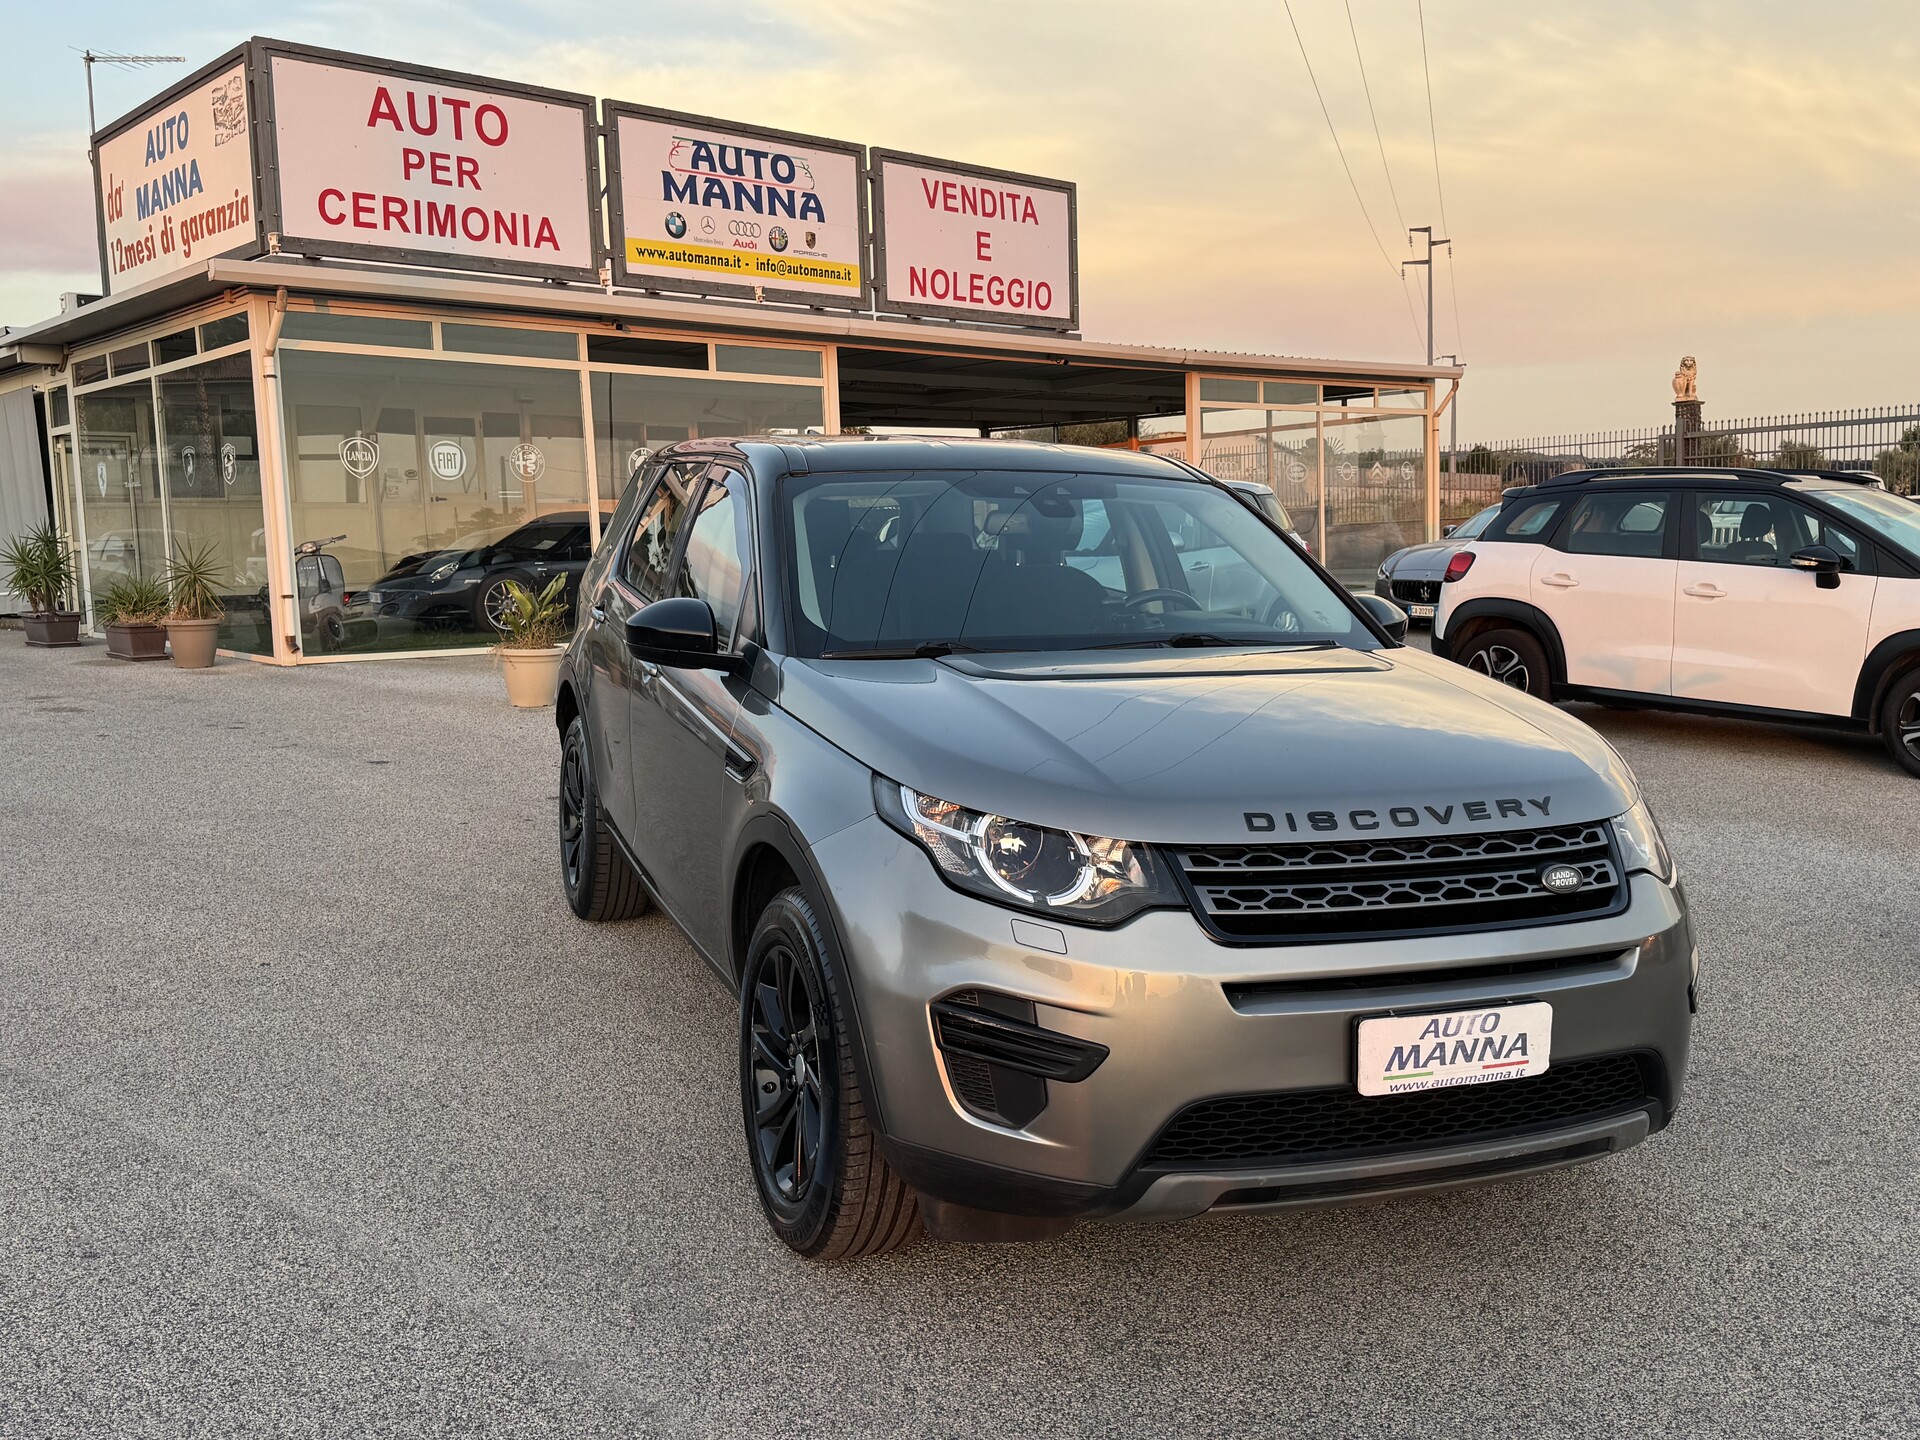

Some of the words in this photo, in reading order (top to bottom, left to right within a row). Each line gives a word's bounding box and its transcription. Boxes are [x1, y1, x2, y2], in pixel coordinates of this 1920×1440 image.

[367, 86, 509, 147] AUTO
[145, 111, 189, 167] AUTO
[402, 147, 482, 191] PER
[691, 139, 795, 184] AUTO
[136, 159, 203, 221] MANNA
[662, 170, 826, 223] MANNA
[921, 177, 1040, 226] VENDITA
[160, 215, 176, 253] di
[180, 188, 250, 258] garanzia
[318, 188, 561, 251] CERIMONIA
[635, 245, 742, 270] www.automanna.it
[755, 257, 852, 281] info@automanna.it
[733, 238, 758, 250] Audi
[793, 249, 828, 258] PORSCHE
[976, 231, 992, 261] E
[909, 266, 1052, 310] NOLEGGIO
[347, 450, 372, 462] LANCIA
[437, 452, 458, 470] FIAT
[1243, 795, 1553, 832] DISCOVERY
[1552, 871, 1571, 879] LAND
[1555, 878, 1577, 887] ROVER
[1419, 1012, 1501, 1040] AUTO
[1384, 1033, 1529, 1072] MANNA
[1389, 1067, 1526, 1092] www.automanna.it
